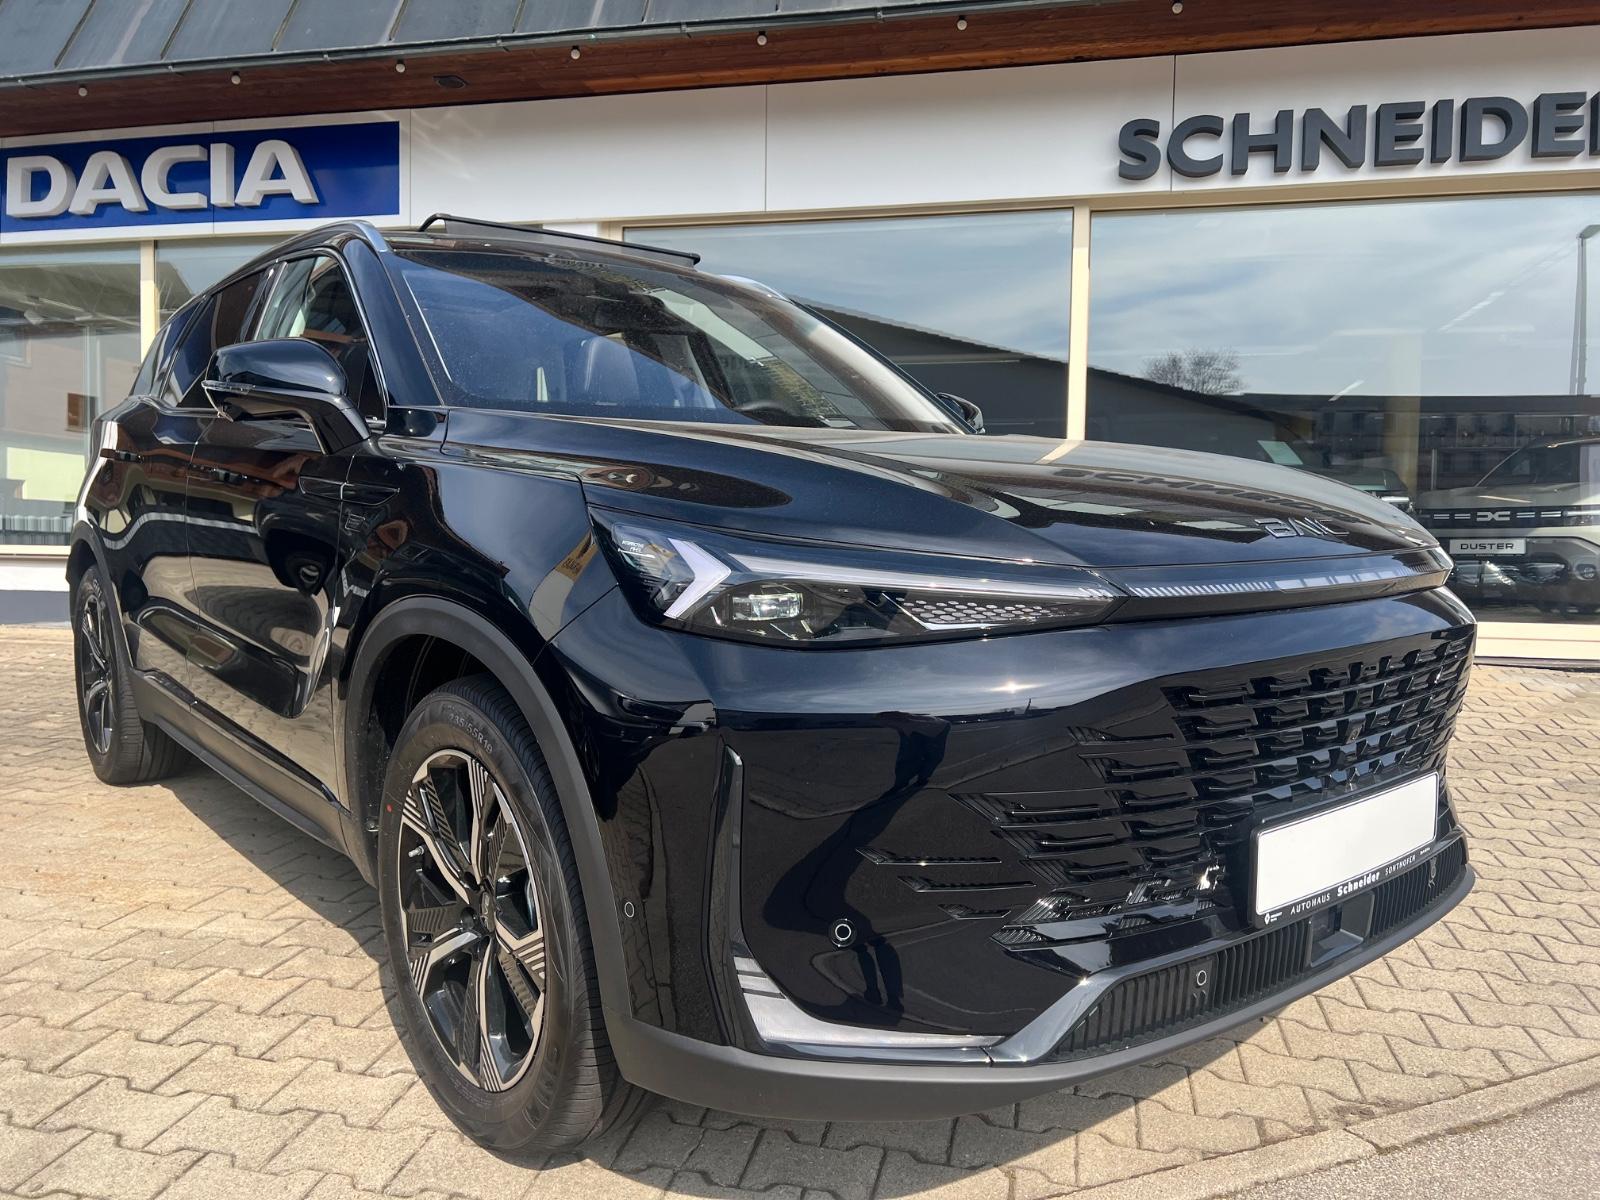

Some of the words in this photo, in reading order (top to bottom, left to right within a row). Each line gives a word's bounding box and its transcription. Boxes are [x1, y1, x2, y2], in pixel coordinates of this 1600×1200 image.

[1118, 91, 1600, 181] SCHNEIDE
[6, 139, 320, 218] DACIA
[1460, 542, 1515, 550] DUSTER
[1290, 892, 1331, 915] AUTOHAUS
[1337, 871, 1380, 897] Schneider
